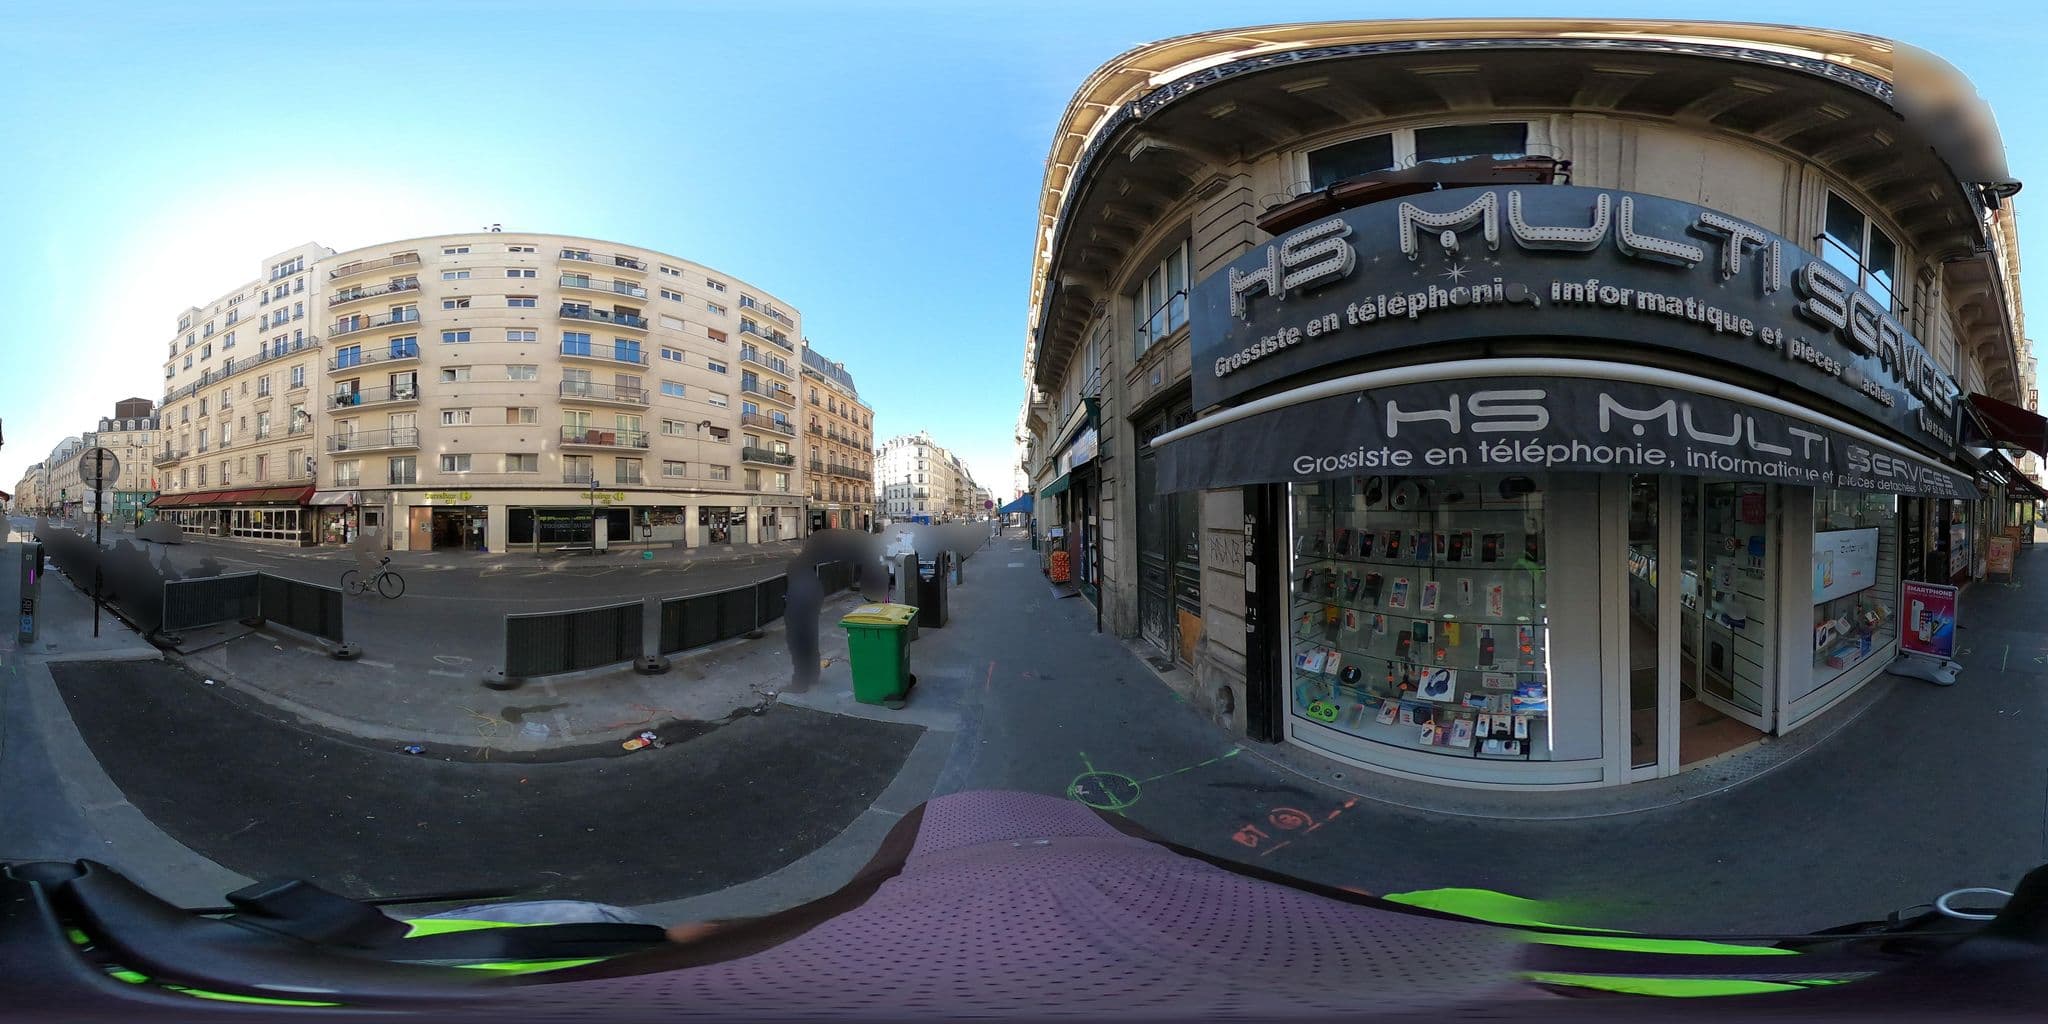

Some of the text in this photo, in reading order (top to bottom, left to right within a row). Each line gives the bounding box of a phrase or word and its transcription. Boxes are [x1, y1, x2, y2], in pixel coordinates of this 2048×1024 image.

[1215, 326, 1302, 377] Grossiste
[1307, 311, 1340, 337] en
[1552, 278, 1754, 337] informatique
[1761, 326, 1783, 346] et
[1229, 189, 1953, 418] HS MULTI SERVICES
[1293, 445, 1413, 475] Grossiste
[1424, 446, 1467, 465] en
[1479, 437, 1676, 468] téléphonie,
[1386, 389, 1954, 488] HS MULTI SERVICES
